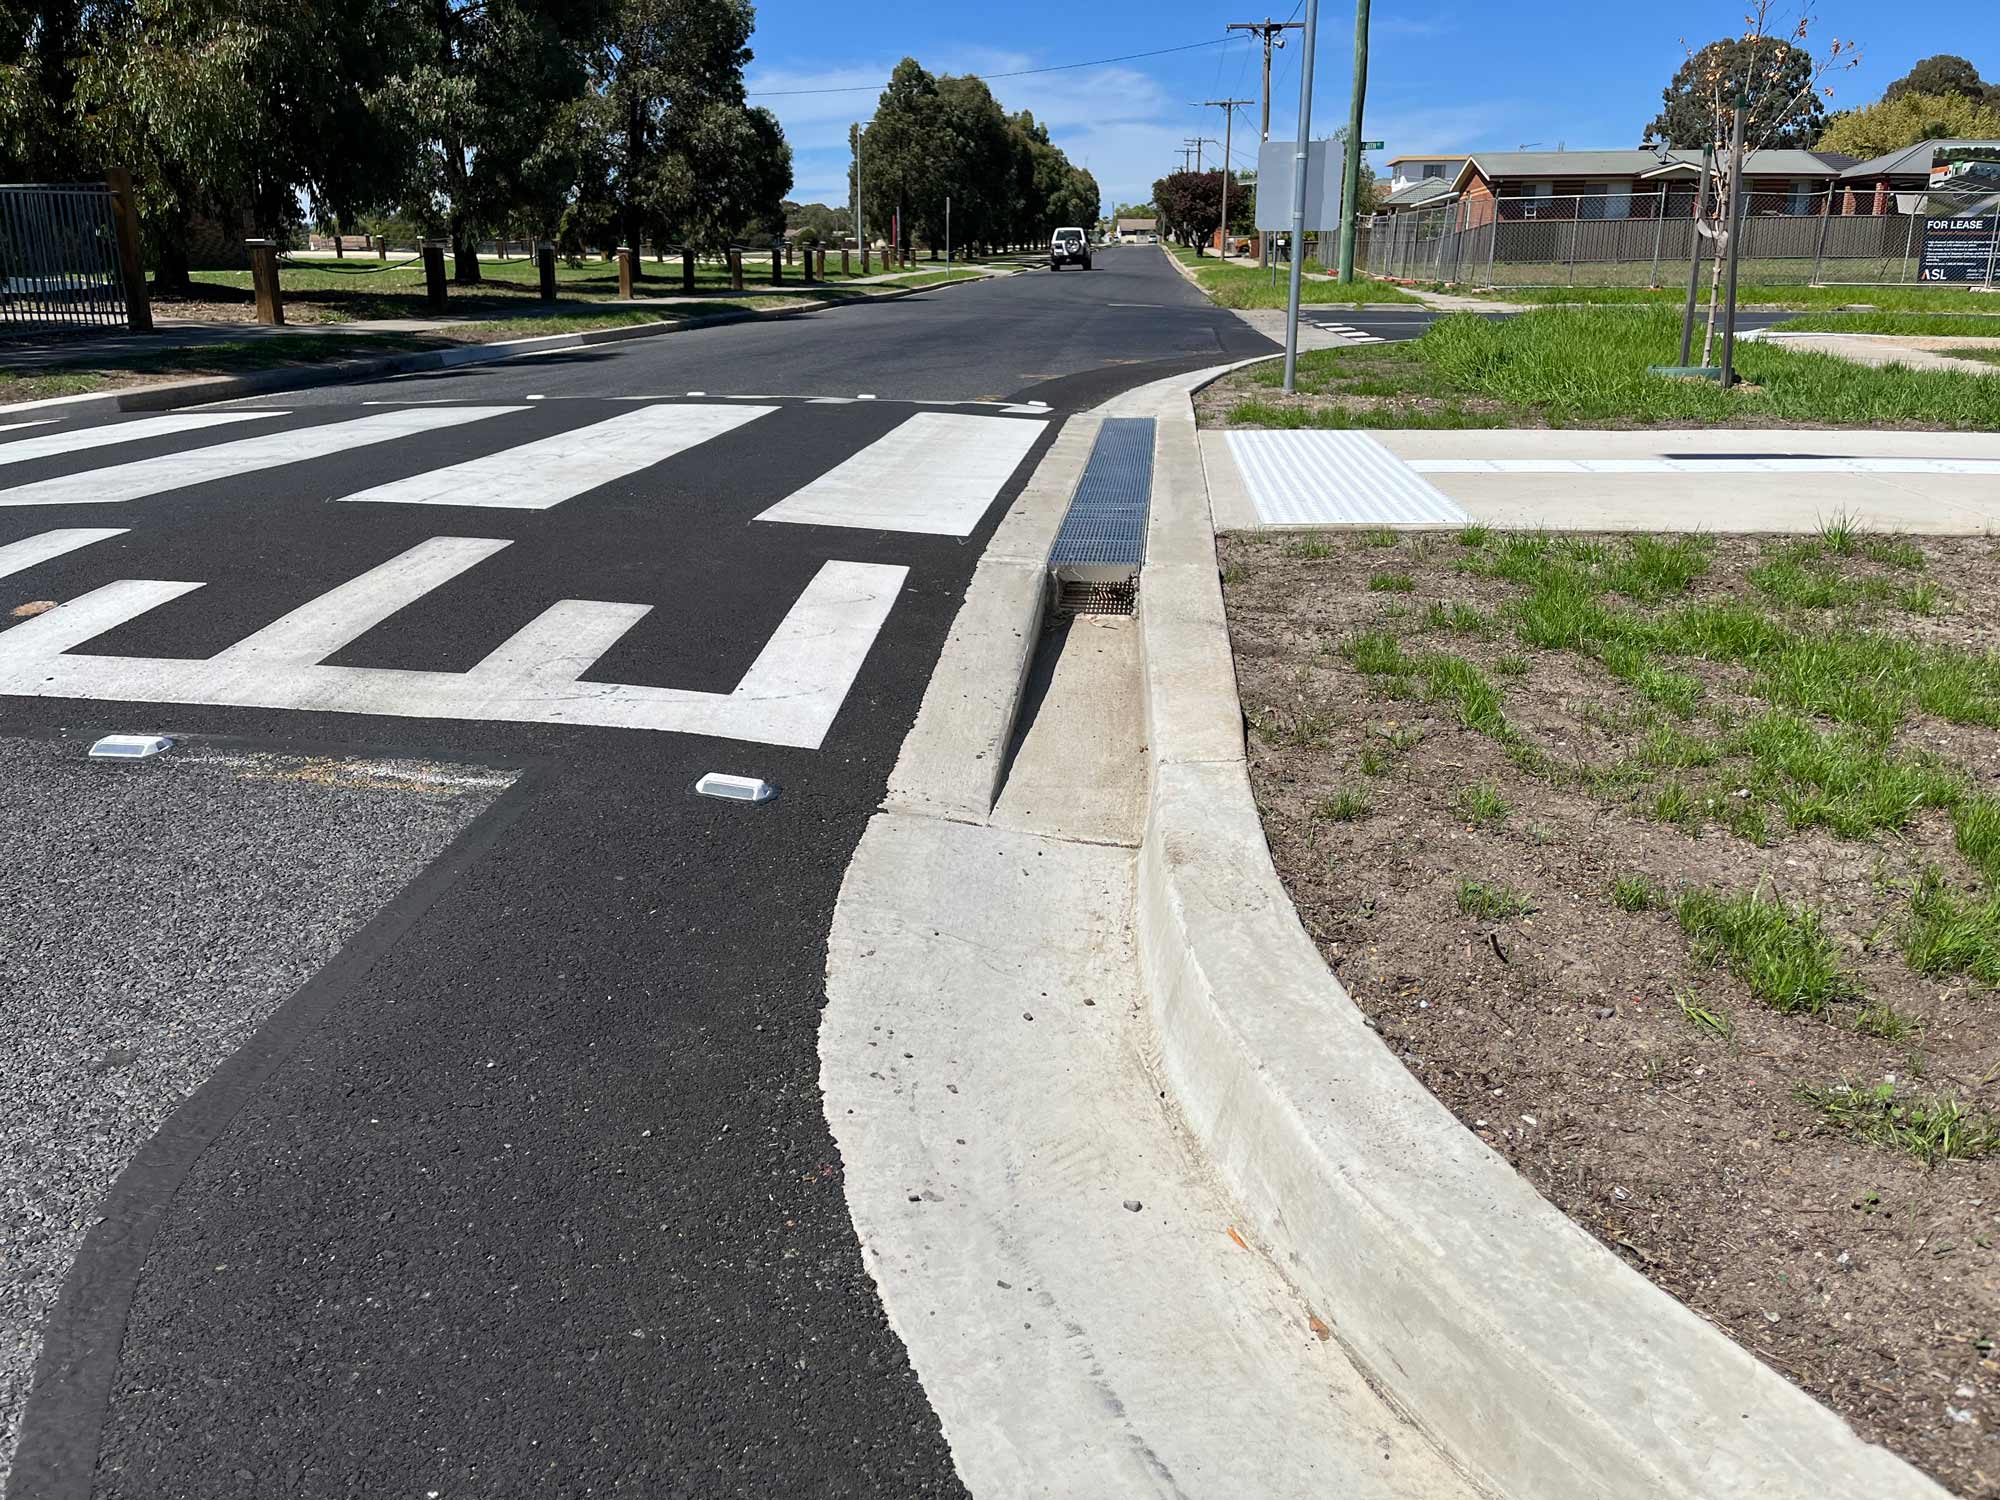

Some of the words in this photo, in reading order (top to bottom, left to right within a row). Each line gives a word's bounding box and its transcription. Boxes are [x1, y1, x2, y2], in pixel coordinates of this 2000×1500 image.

[1927, 220, 1949, 229] FOR
[1950, 220, 1984, 229] LEASE
[1921, 269, 1947, 280] ASL
